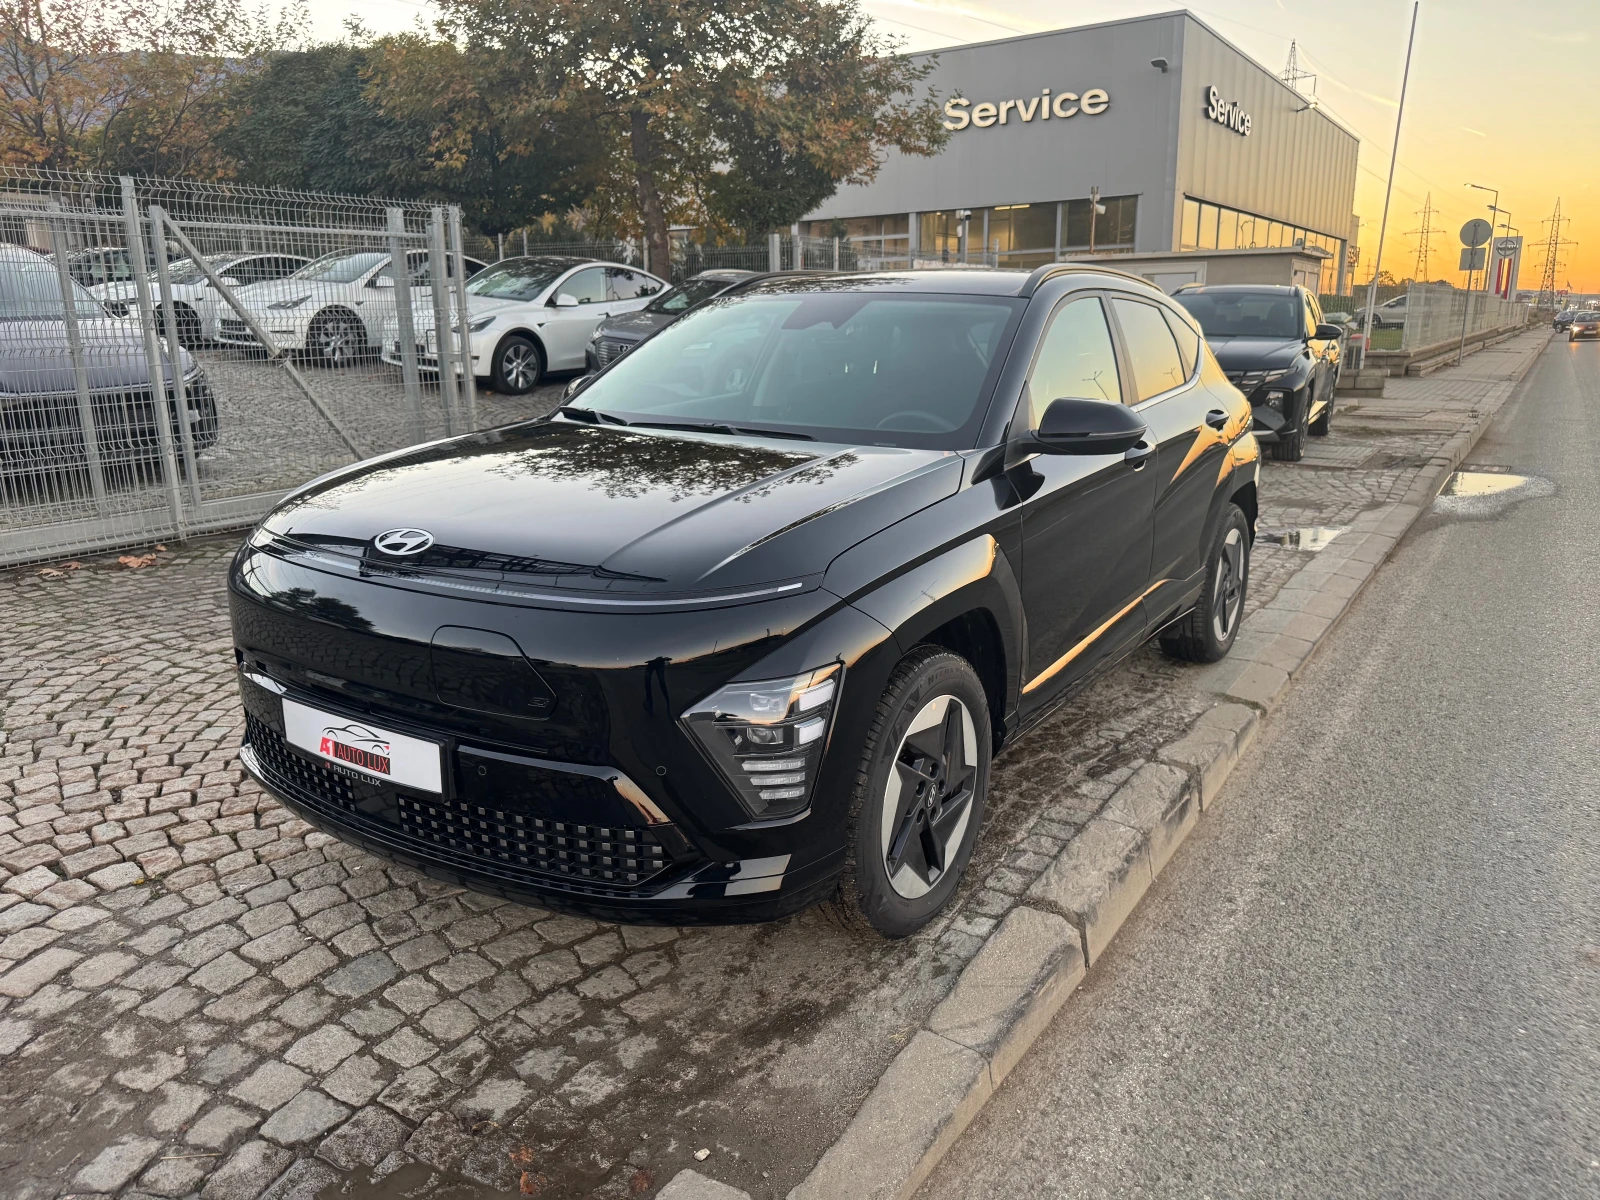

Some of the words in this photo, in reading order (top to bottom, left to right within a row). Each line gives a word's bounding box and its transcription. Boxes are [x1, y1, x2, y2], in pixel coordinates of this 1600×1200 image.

[942, 88, 1111, 131] Service
[1207, 85, 1251, 137] Service
[333, 764, 359, 779] AUTO
[360, 774, 382, 787] LUX
[337, 743, 364, 767] AUTO
[367, 752, 389, 775] LUX
